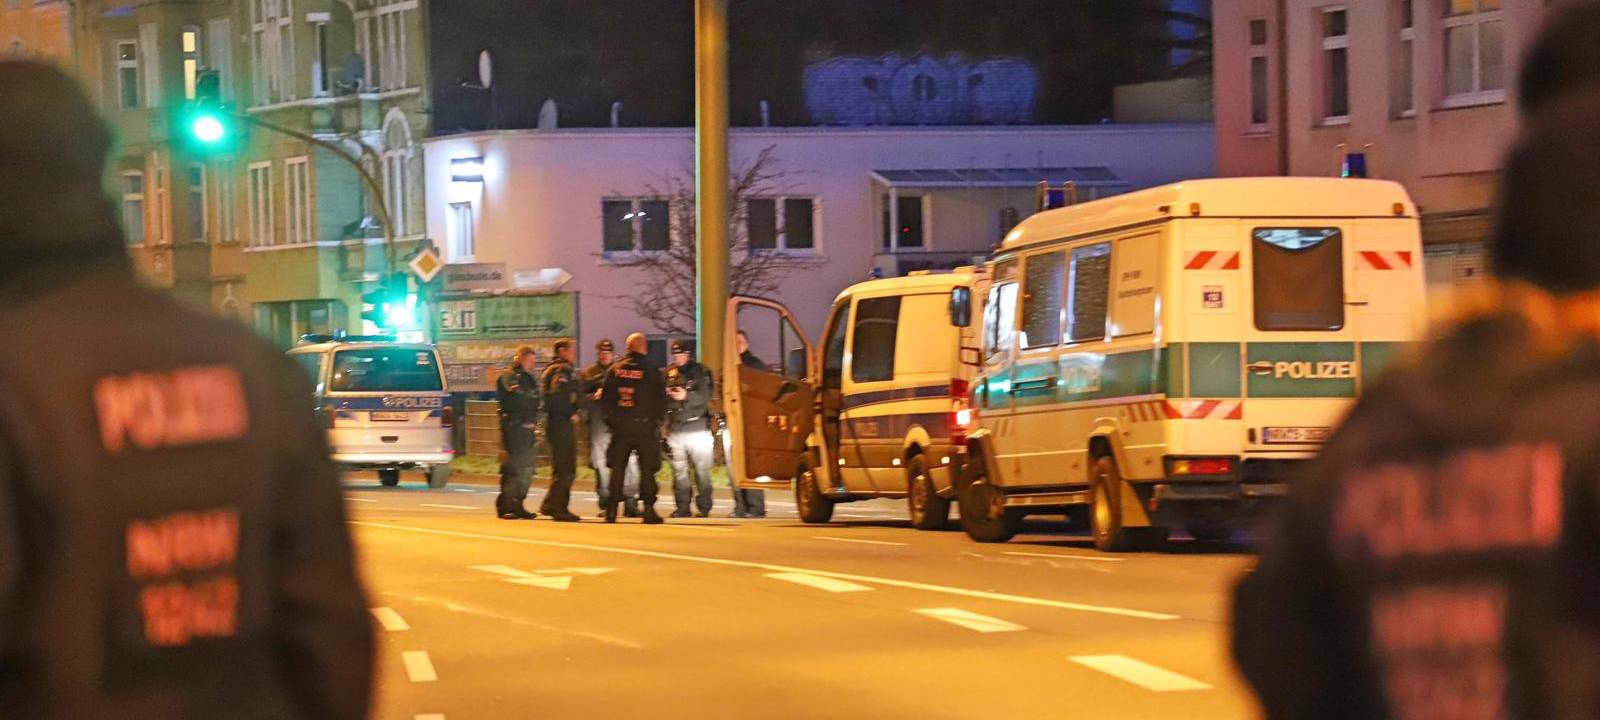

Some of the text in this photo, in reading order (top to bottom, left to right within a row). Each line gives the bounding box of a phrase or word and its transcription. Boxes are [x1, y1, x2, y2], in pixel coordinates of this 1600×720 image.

[1275, 361, 1356, 379] POLIZEI
[94, 364, 248, 454] POLIZEI
[394, 397, 442, 408] POLIZEI
[126, 510, 240, 577] NRW
